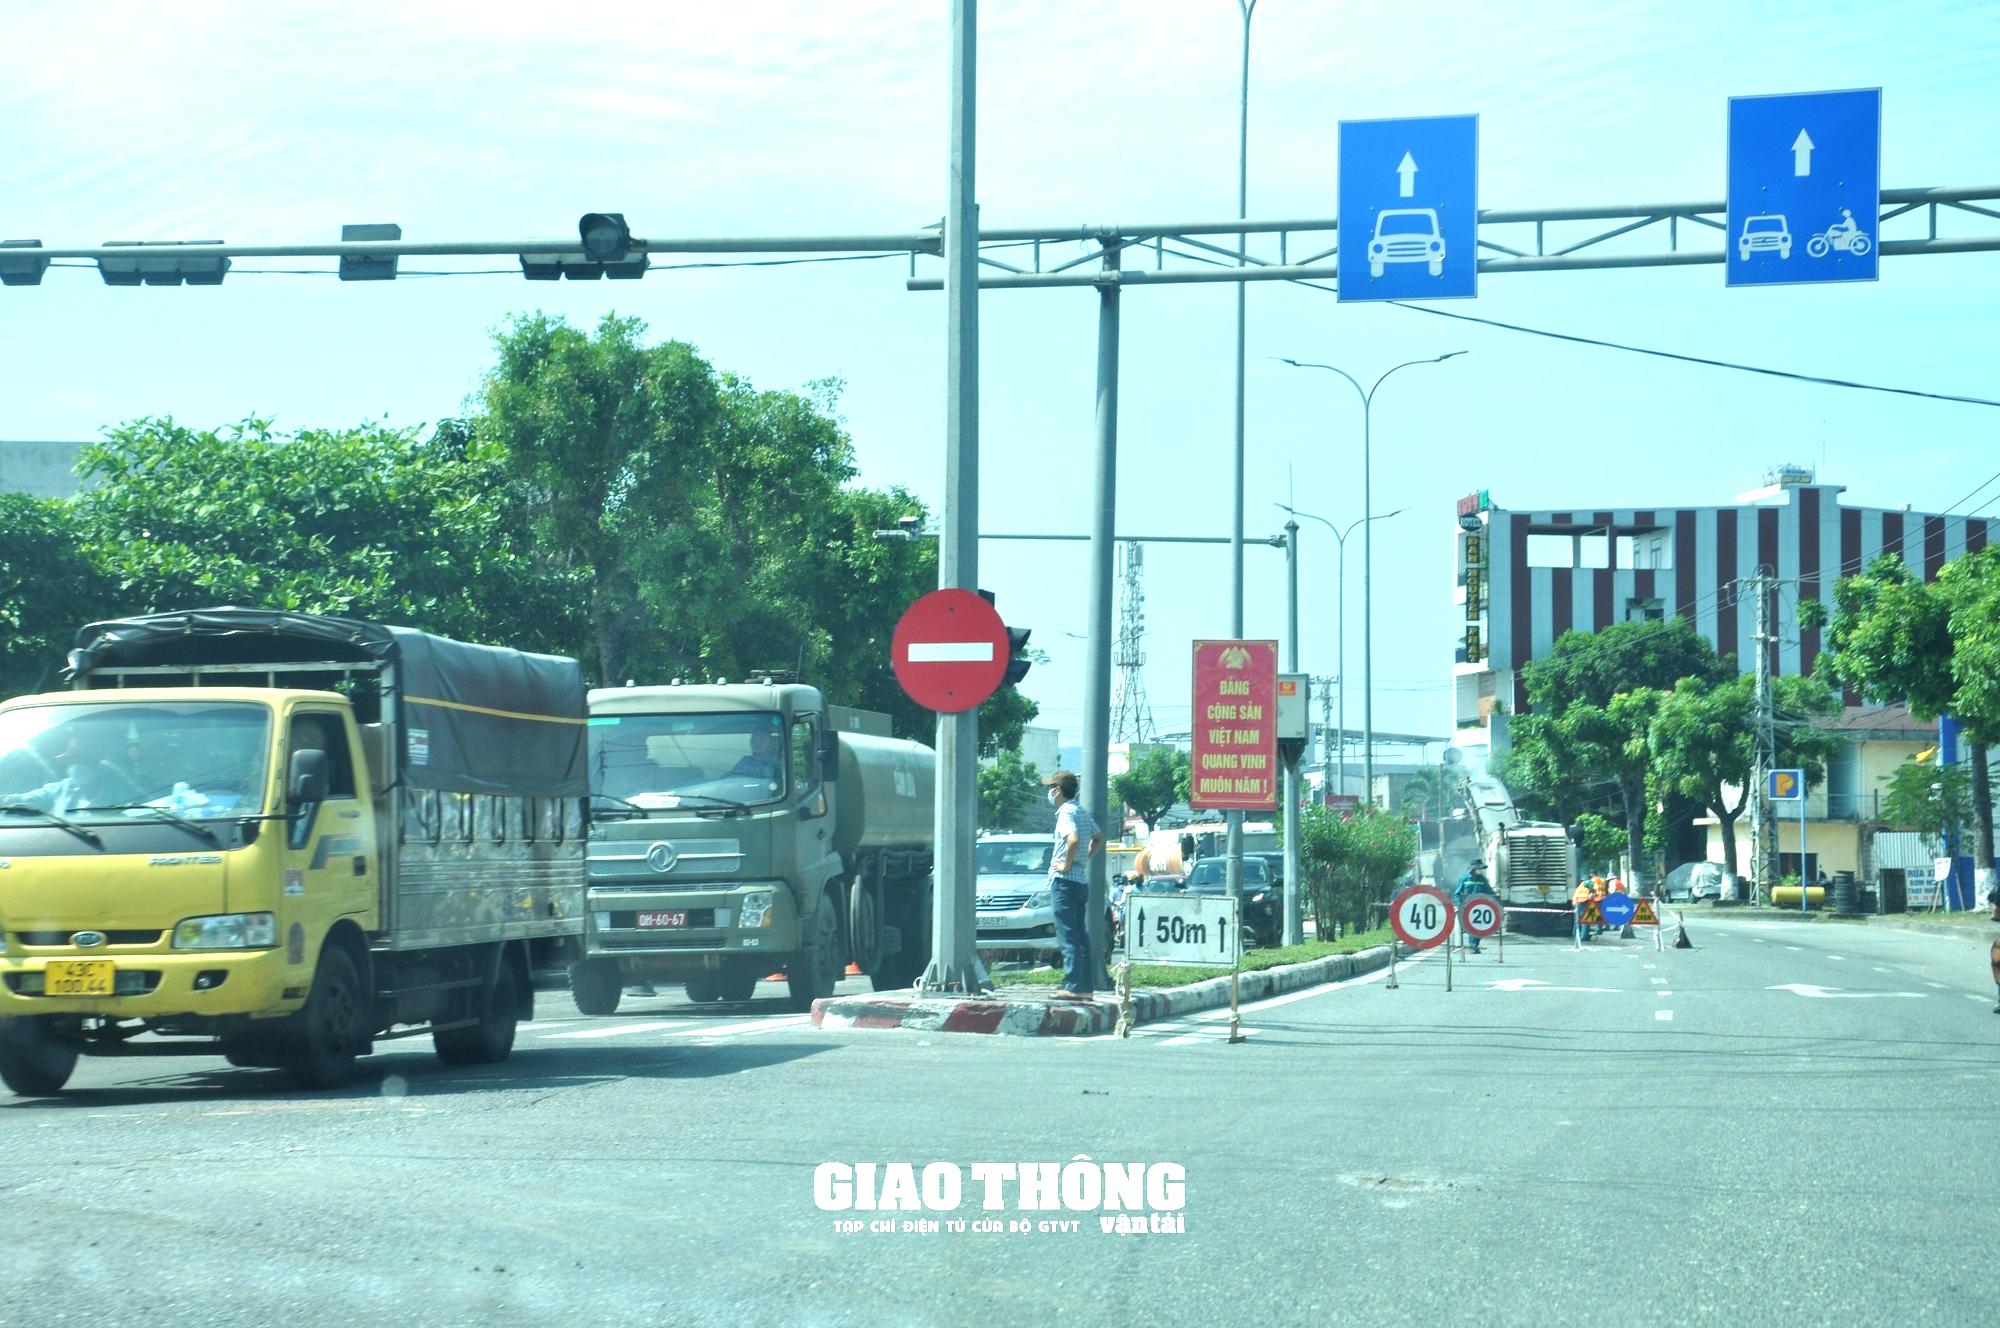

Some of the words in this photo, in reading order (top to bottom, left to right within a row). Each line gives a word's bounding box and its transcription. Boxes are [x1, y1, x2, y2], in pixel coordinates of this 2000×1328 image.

[1220, 676, 1250, 696] ĐẢNG
[1207, 702, 1237, 723] CỘNG
[1239, 701, 1262, 720] SẢN
[1208, 727, 1232, 748] VIỆT
[1234, 729, 1260, 744] NAM
[1202, 754, 1238, 770] QUANG
[1240, 755, 1266, 769] VINH
[1200, 775, 1232, 793] MUÔN
[1235, 776, 1260, 793] NĂM
[149, 855, 222, 866] FRONTIER
[1410, 903, 1436, 930] 40
[1472, 909, 1492, 924] 20
[1156, 916, 1206, 944] 50m
[65, 962, 95, 977] 43C
[54, 978, 106, 993] 100.44
